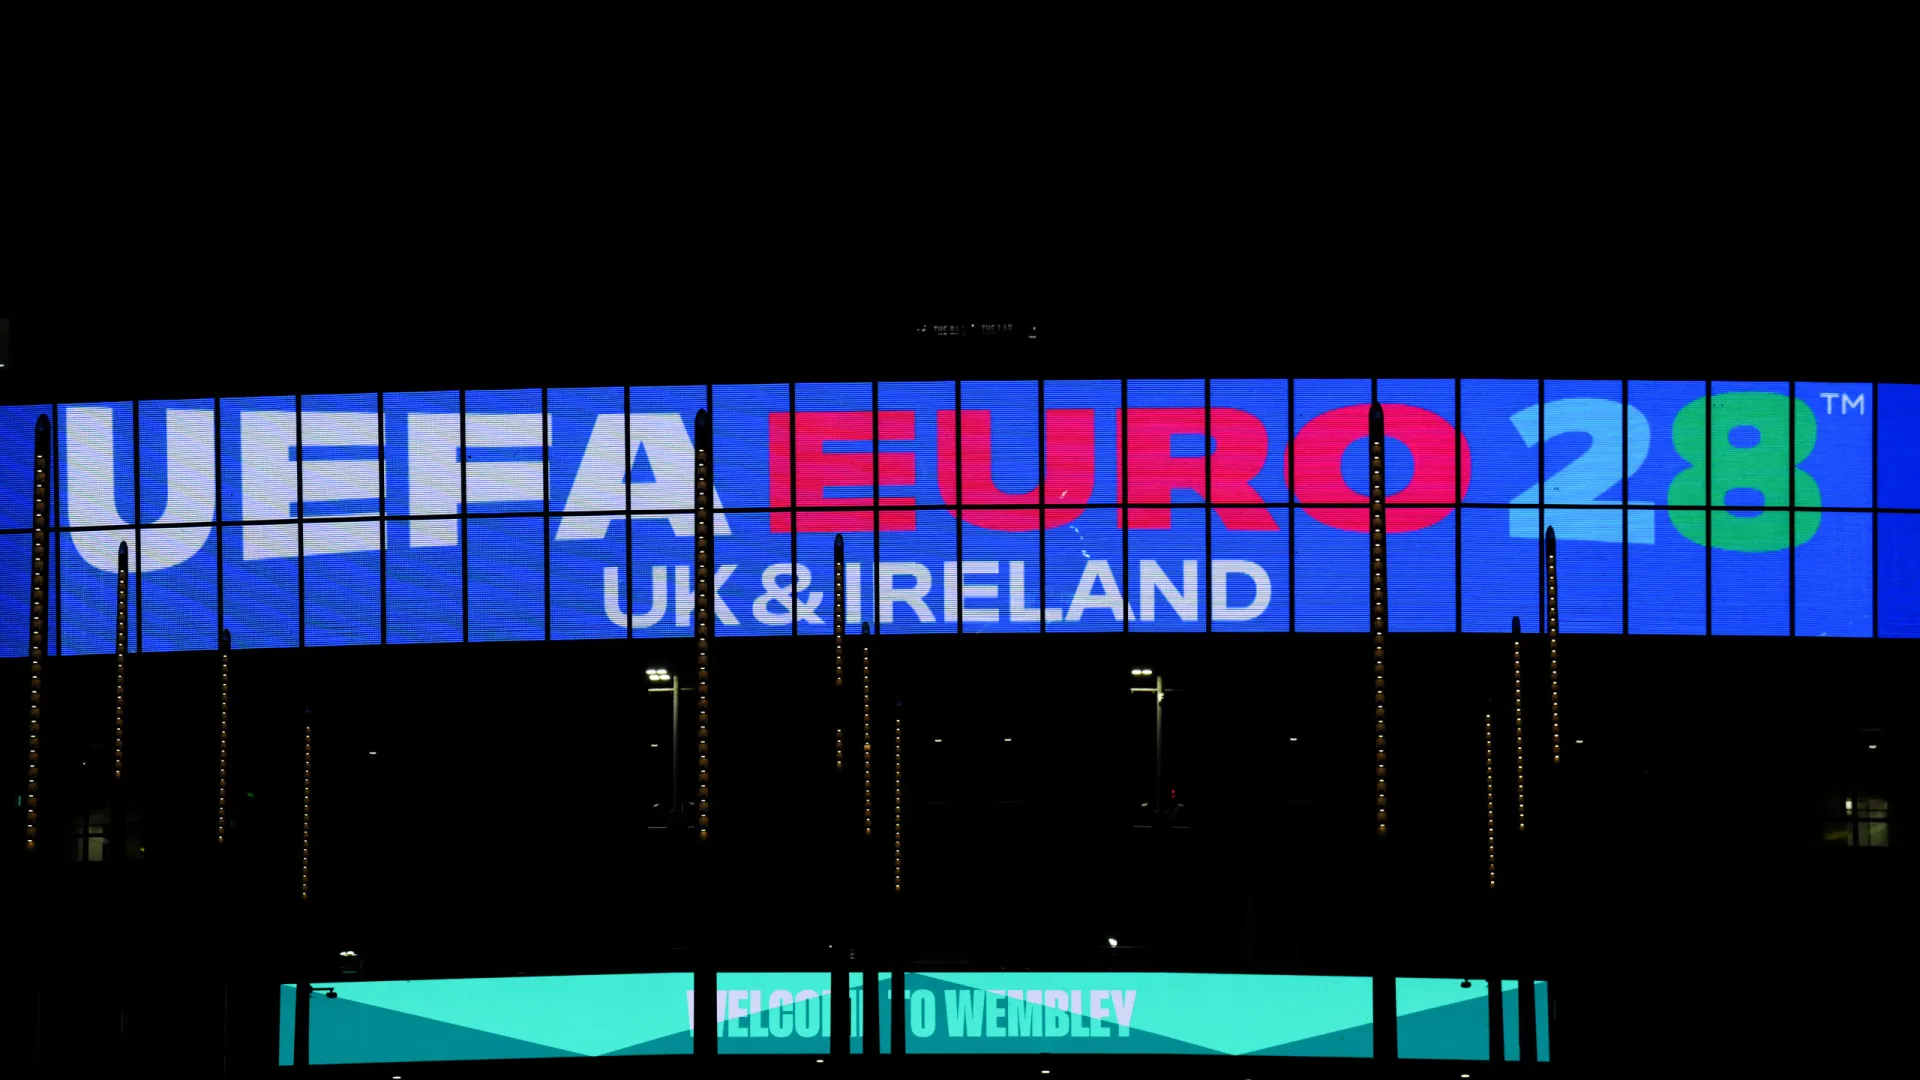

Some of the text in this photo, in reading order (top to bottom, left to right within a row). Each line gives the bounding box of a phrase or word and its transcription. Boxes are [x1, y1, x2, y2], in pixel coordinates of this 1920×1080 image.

[64, 406, 733, 574] UEFA
[768, 403, 1471, 533] EURO
[1509, 391, 1821, 552] 28
[602, 560, 1272, 629] UK & IRELAND
[944, 989, 1137, 1038] WEMBLEY
